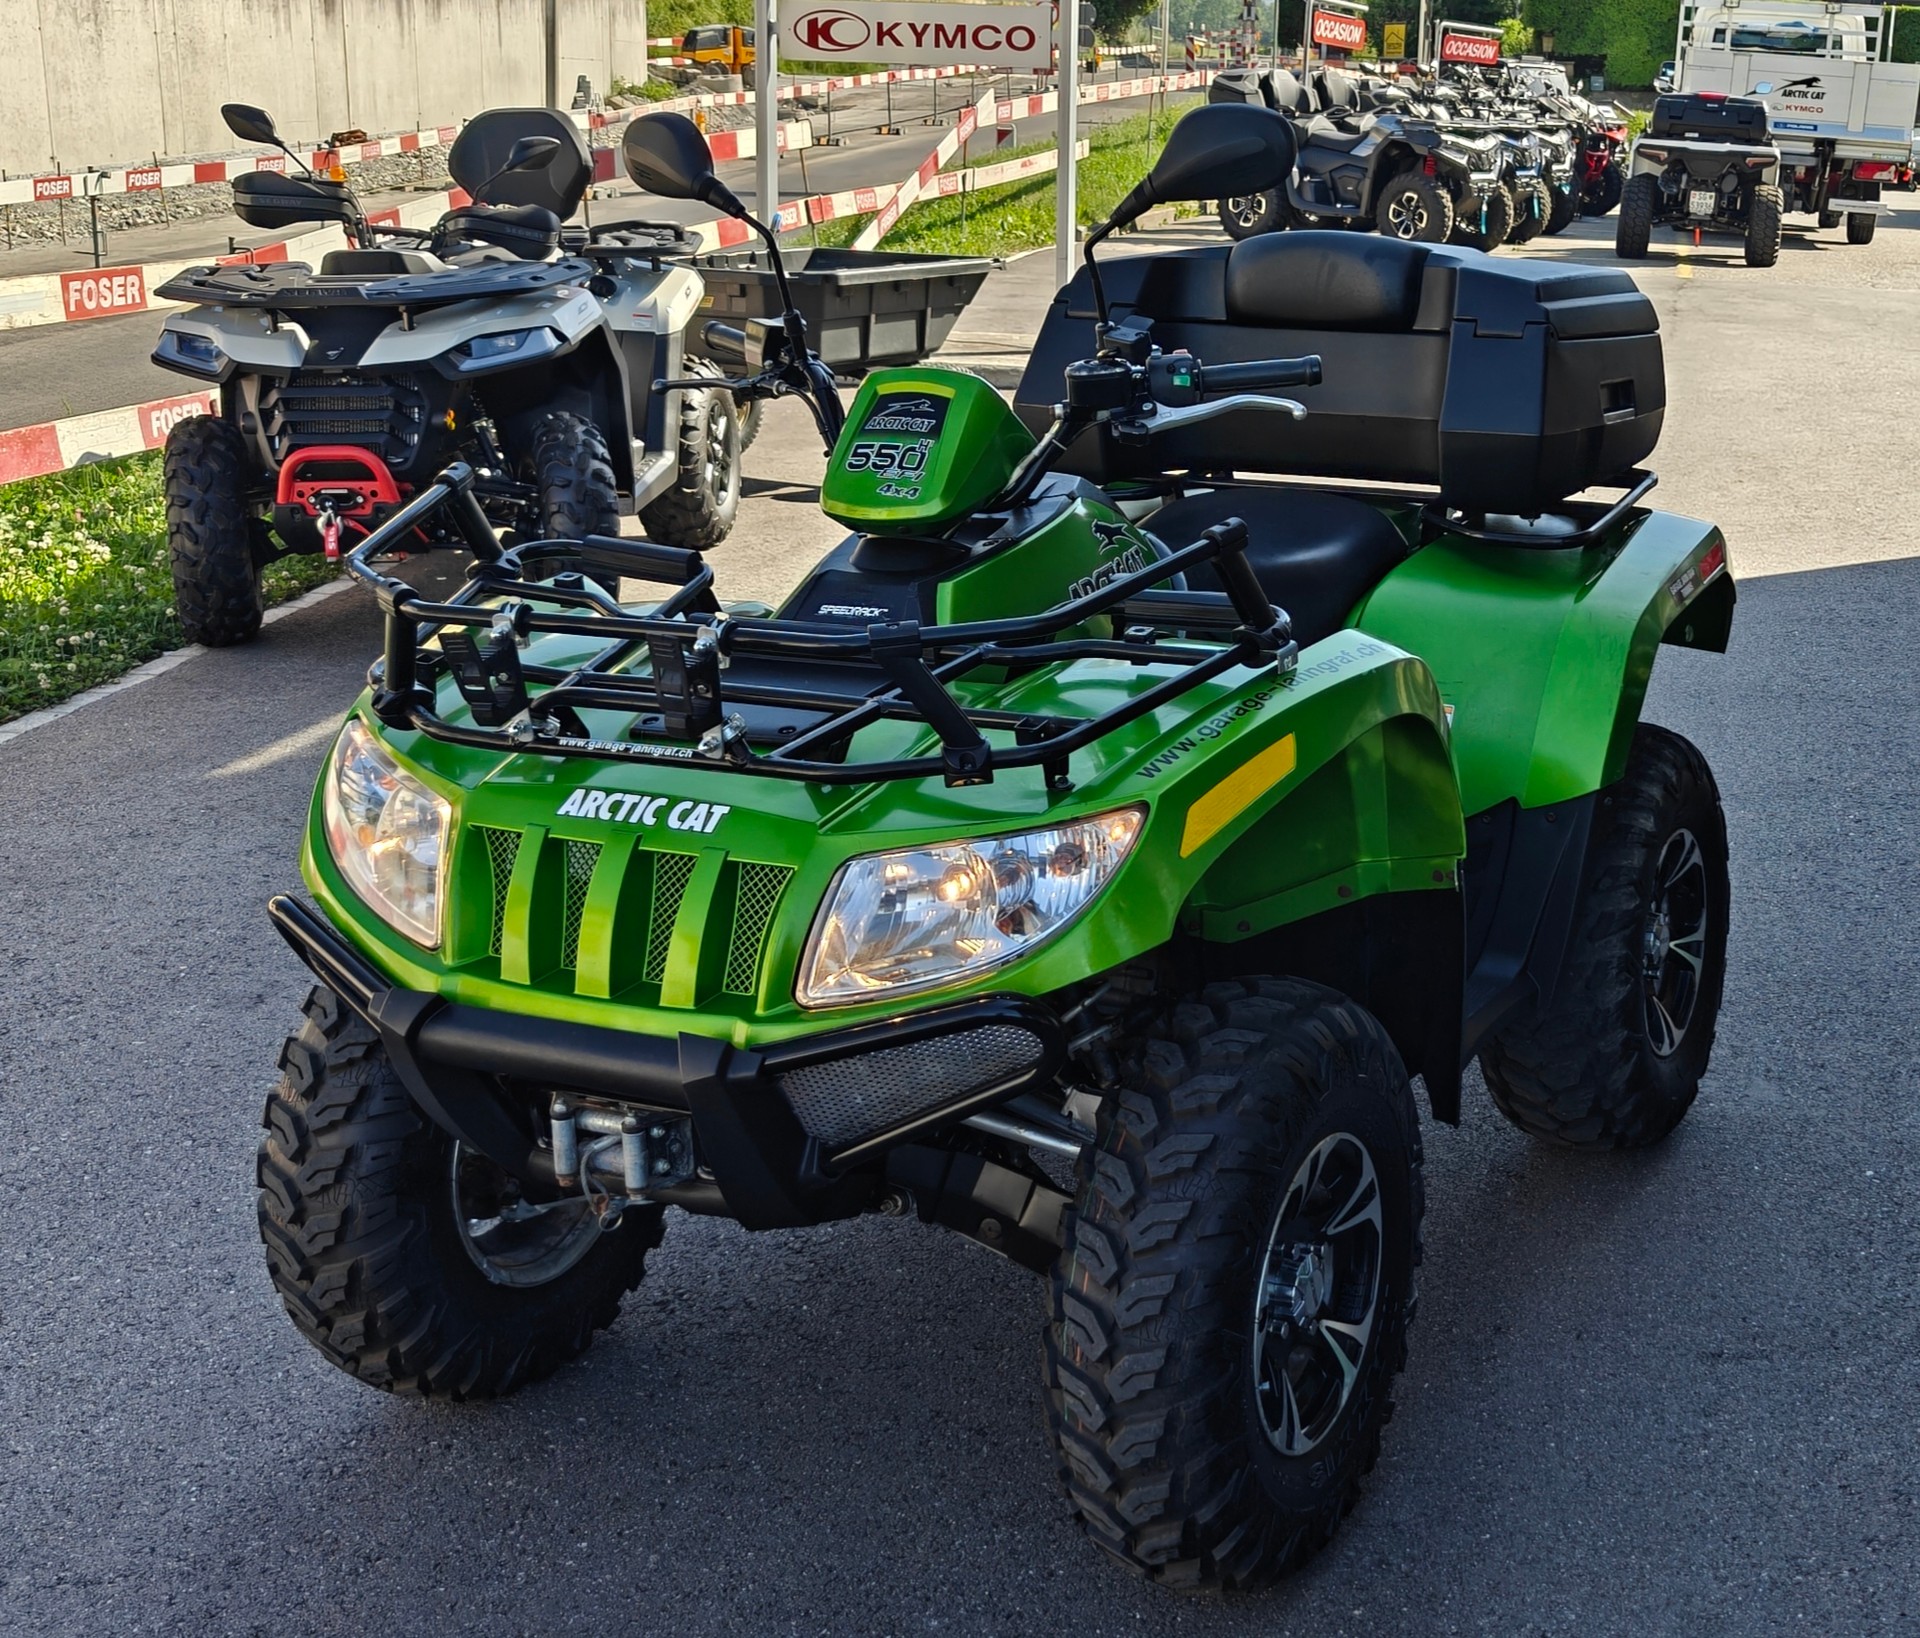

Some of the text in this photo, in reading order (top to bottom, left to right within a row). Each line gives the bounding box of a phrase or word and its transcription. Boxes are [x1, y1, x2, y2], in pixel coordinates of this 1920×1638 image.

[876, 21, 1036, 51] KYMCO
[1315, 19, 1363, 43] OCCASION
[1445, 41, 1497, 59] OCCASION
[1781, 89, 1827, 100] ARCTIC CAT
[1785, 104, 1824, 113] KYMCO
[128, 170, 161, 187] FOSER
[36, 179, 71, 197] FOSER
[68, 274, 142, 312] FOSER
[864, 416, 936, 433] ARCTIC CAT
[558, 737, 693, 759] www.garage-janngraf.ch
[556, 788, 731, 834] ARCTIC CAT
